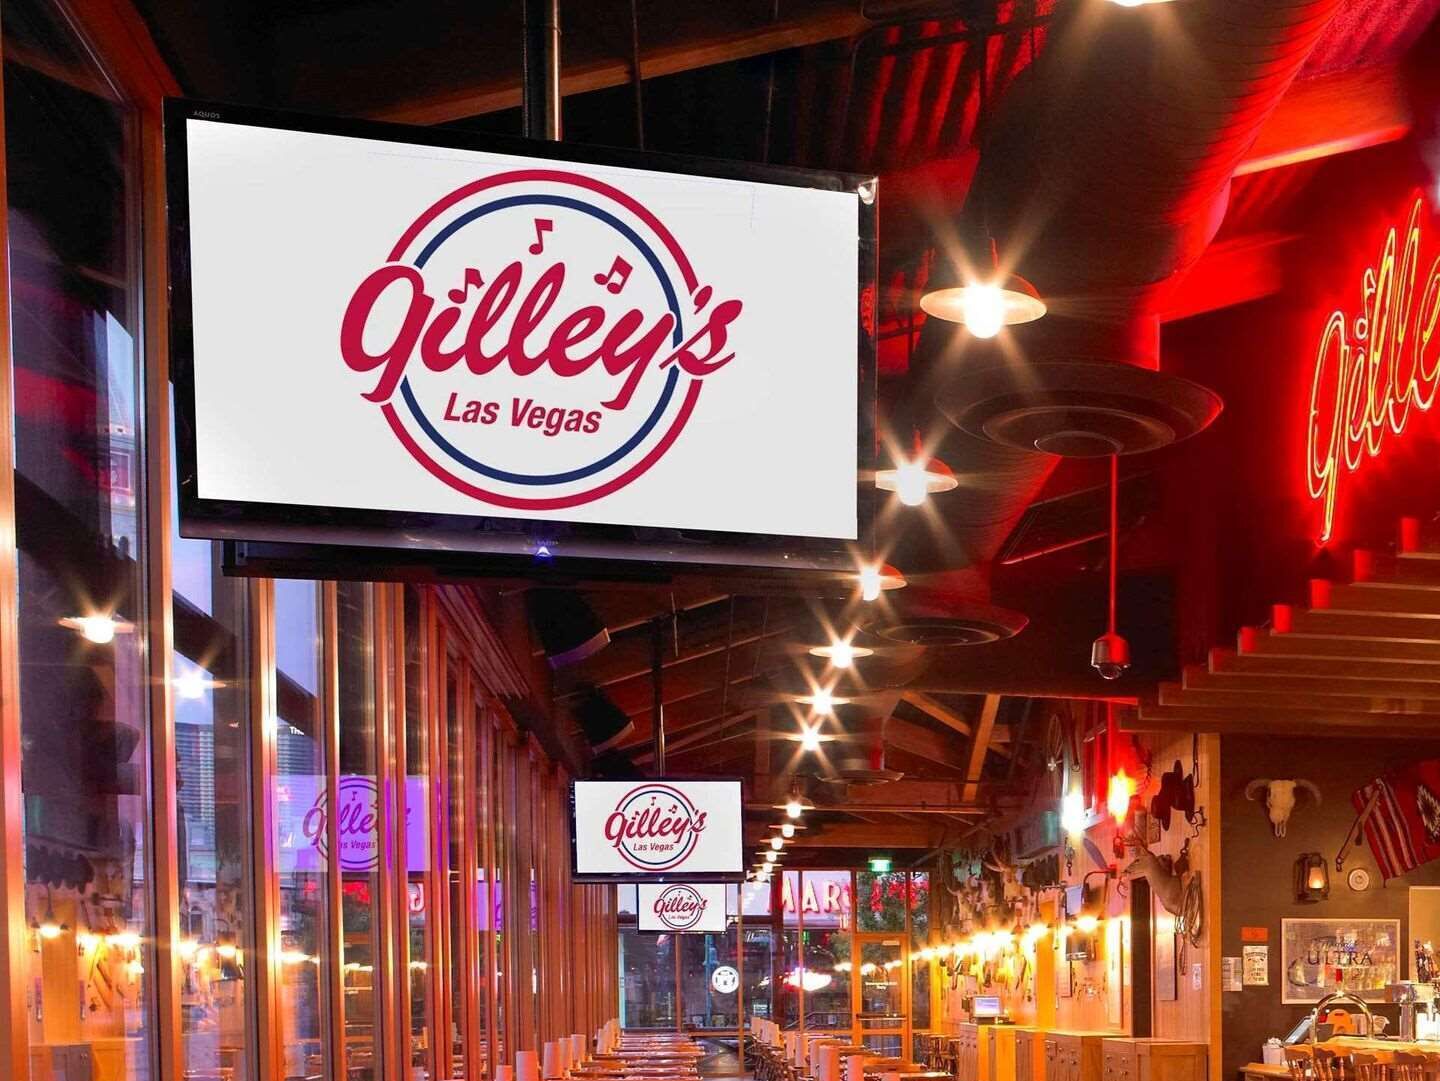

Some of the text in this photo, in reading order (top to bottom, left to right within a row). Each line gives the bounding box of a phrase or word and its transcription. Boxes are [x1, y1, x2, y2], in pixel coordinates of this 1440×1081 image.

[339, 260, 744, 411] Gilley's
[443, 391, 603, 437] Las Vegas
[604, 807, 708, 848] Gilley's
[633, 842, 675, 853] Las Vegas
[653, 896, 708, 918] Gilley's
[1308, 950, 1373, 966] ULTRA
